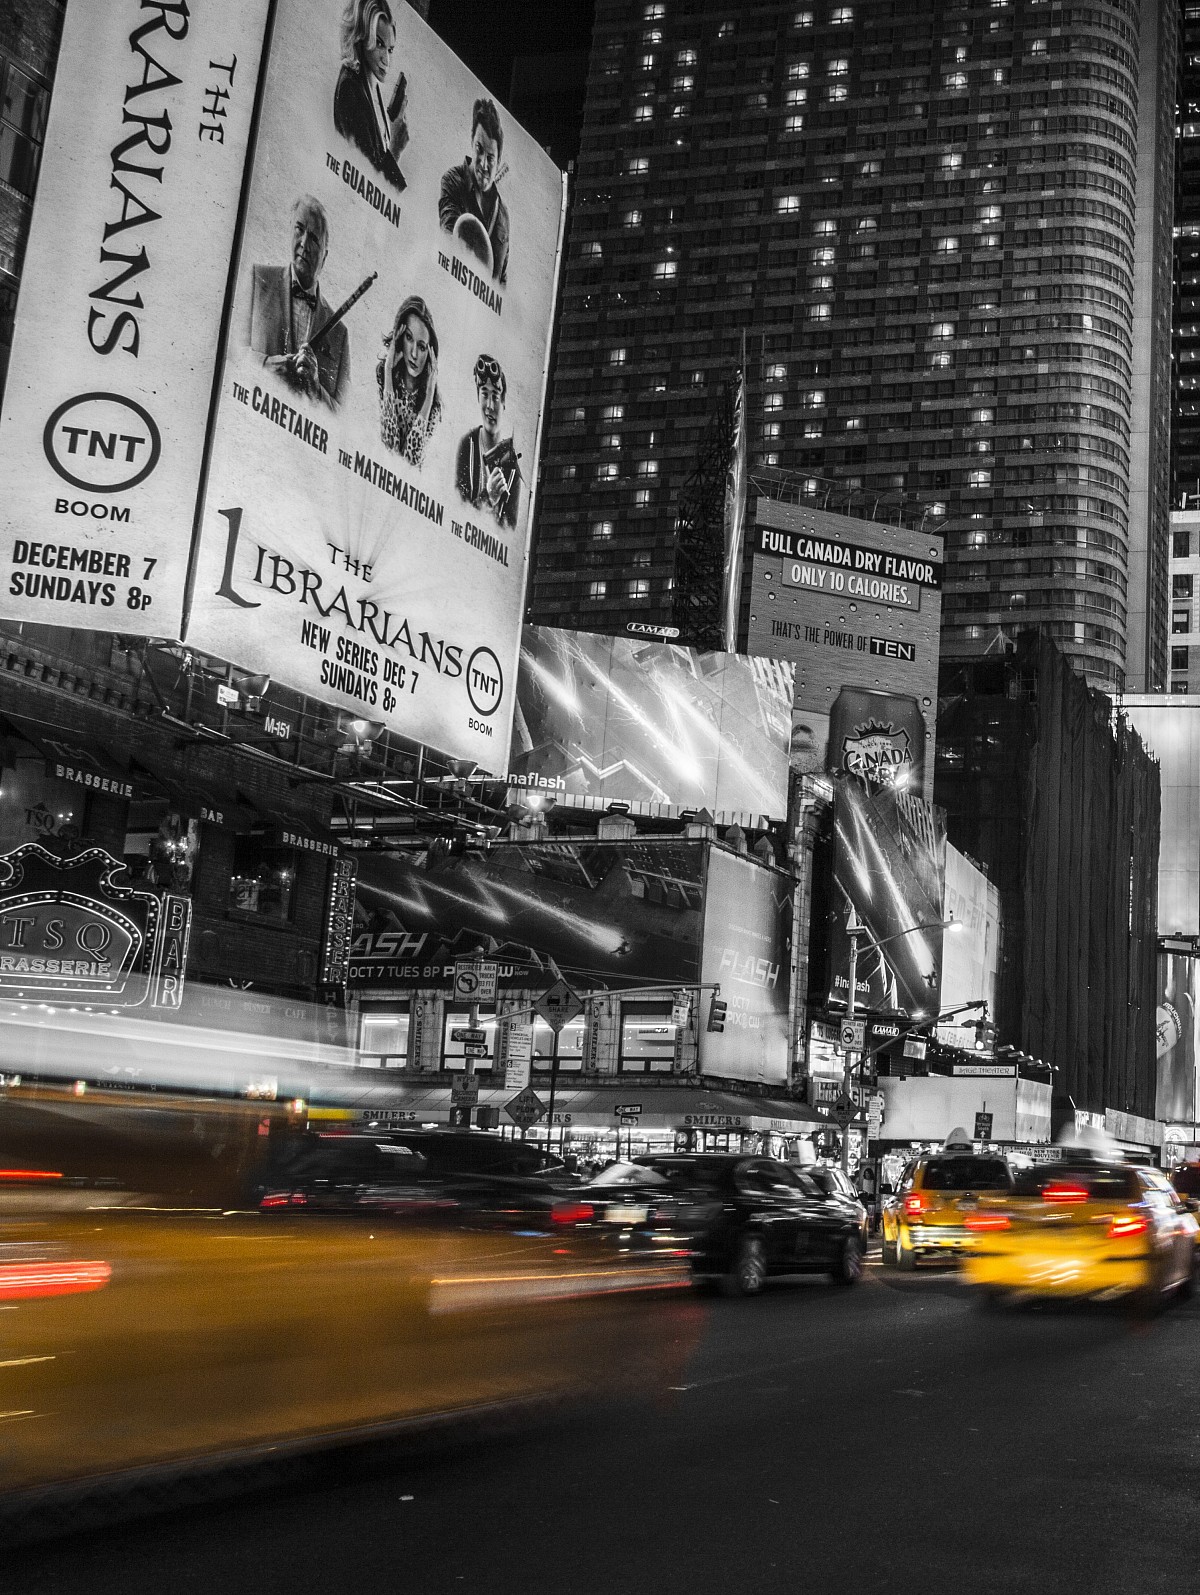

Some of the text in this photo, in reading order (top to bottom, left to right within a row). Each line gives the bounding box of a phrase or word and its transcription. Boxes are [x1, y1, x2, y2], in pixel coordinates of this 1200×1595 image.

[199, 54, 238, 145] THE
[326, 151, 401, 228] THE GUARDIAN
[438, 251, 502, 316] THE HISTORIAN
[233, 381, 329, 454] THE CARETAKER
[61, 425, 146, 462] TNT
[338, 448, 444, 526] THE MATHEMATICIAN
[54, 498, 131, 523] BOOM
[12, 540, 157, 581] DECEMBER 7
[327, 542, 373, 583] THE
[451, 519, 508, 567] THE CRIMINAL
[761, 530, 938, 585] FULL CANADA DRY FLAVOR.
[9, 571, 116, 607] SUNDAYS
[215, 507, 464, 679] LIBRARIANS
[791, 564, 912, 605] ONLY 10 CALORIES.
[631, 625, 675, 636] LAMAR
[771, 619, 912, 659] THAT'S THE POWER OF TEN
[301, 618, 419, 694] NEW SERIES DEC 7
[320, 659, 378, 706] SUNDAYS
[472, 669, 498, 698] TNT
[264, 716, 290, 739] M-151
[468, 717, 493, 738] BOOM
[56, 764, 133, 797] BRASSERIE
[843, 747, 912, 778] CANADA
[282, 832, 338, 857] BRASSERIE
[162, 902, 184, 1006] BAR
[350, 966, 374, 978] OCT
[376, 966, 385, 978] 7
[387, 966, 419, 977] TUES
[423, 966, 440, 978] 8P
[484, 963, 496, 971] AREA
[718, 948, 780, 989] FLASH
[457, 1031, 482, 1040] ONE WAY
[590, 1021, 599, 1069] SMILER'S
[874, 1026, 897, 1035] LAMAR
[362, 1110, 416, 1120] SMILER'S
[684, 1115, 741, 1126] SMILER'S
